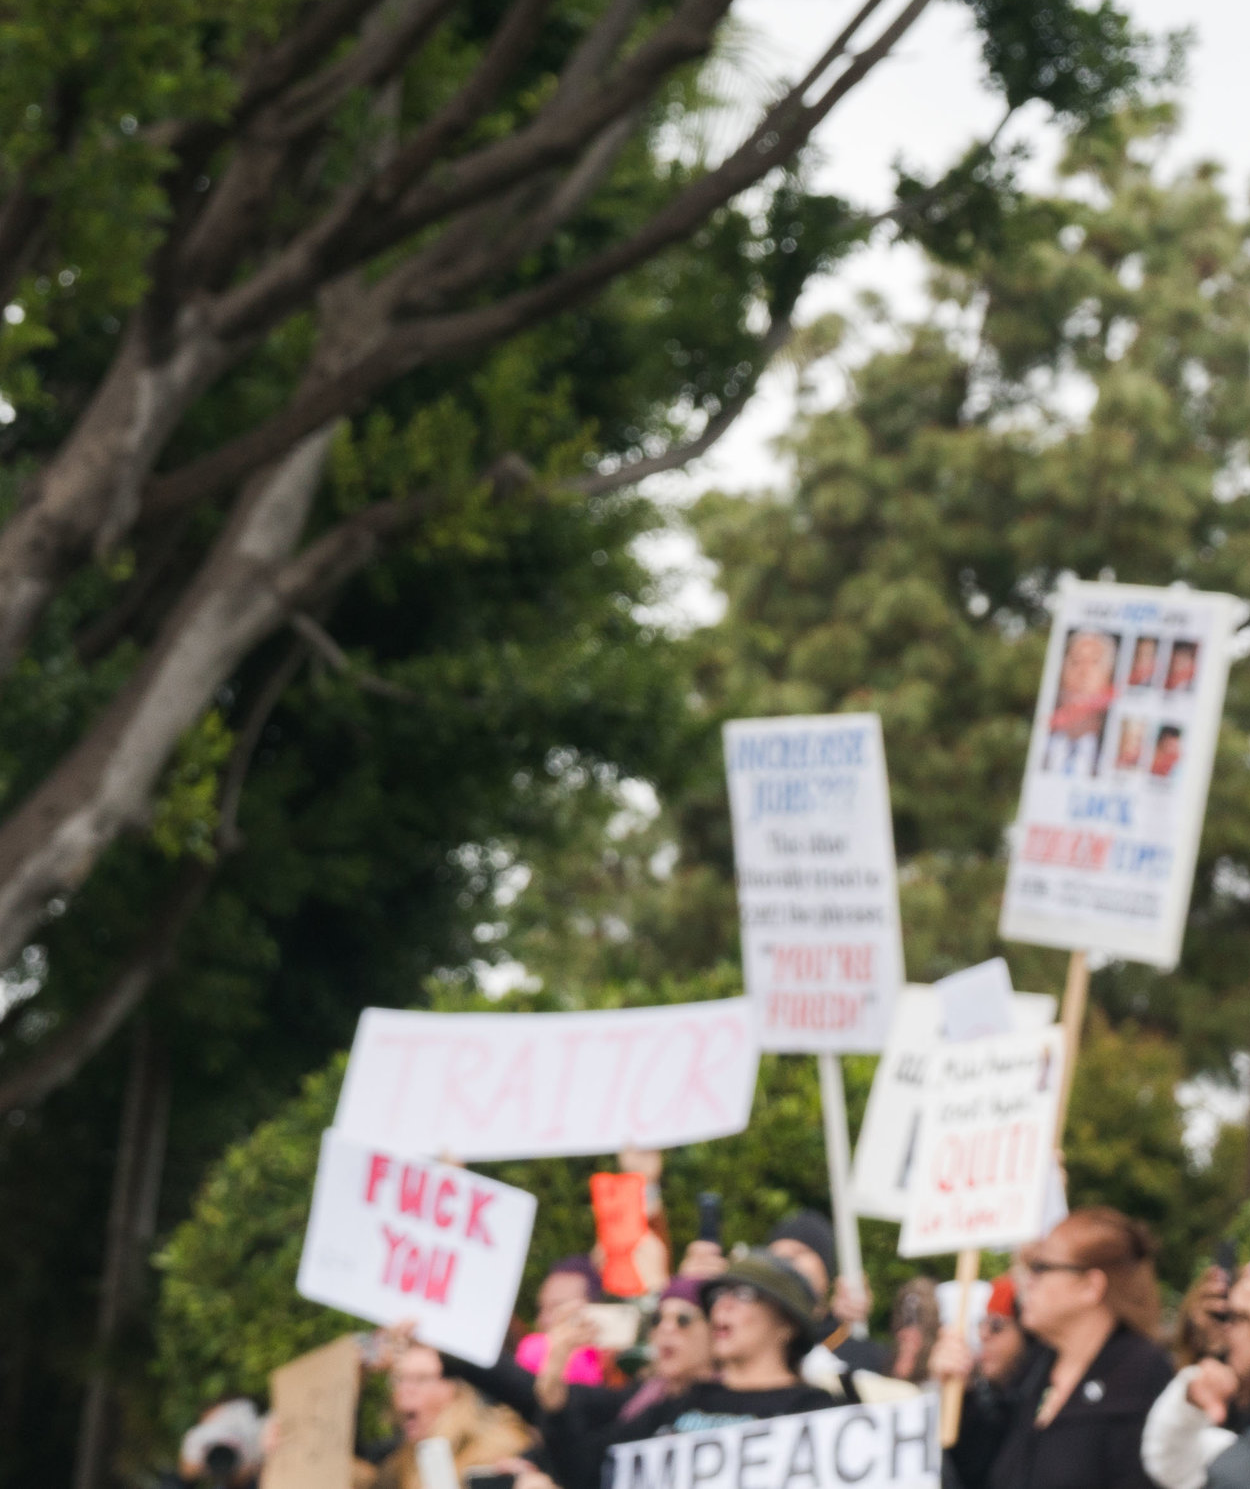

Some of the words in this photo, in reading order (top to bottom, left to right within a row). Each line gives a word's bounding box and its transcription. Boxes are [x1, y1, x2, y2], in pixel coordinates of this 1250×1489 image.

[374, 1016, 746, 1141] TRAITOR
[363, 1154, 497, 1247] FUCK
[380, 1223, 458, 1305] YOU
[602, 1400, 935, 1489] IMPEACH
